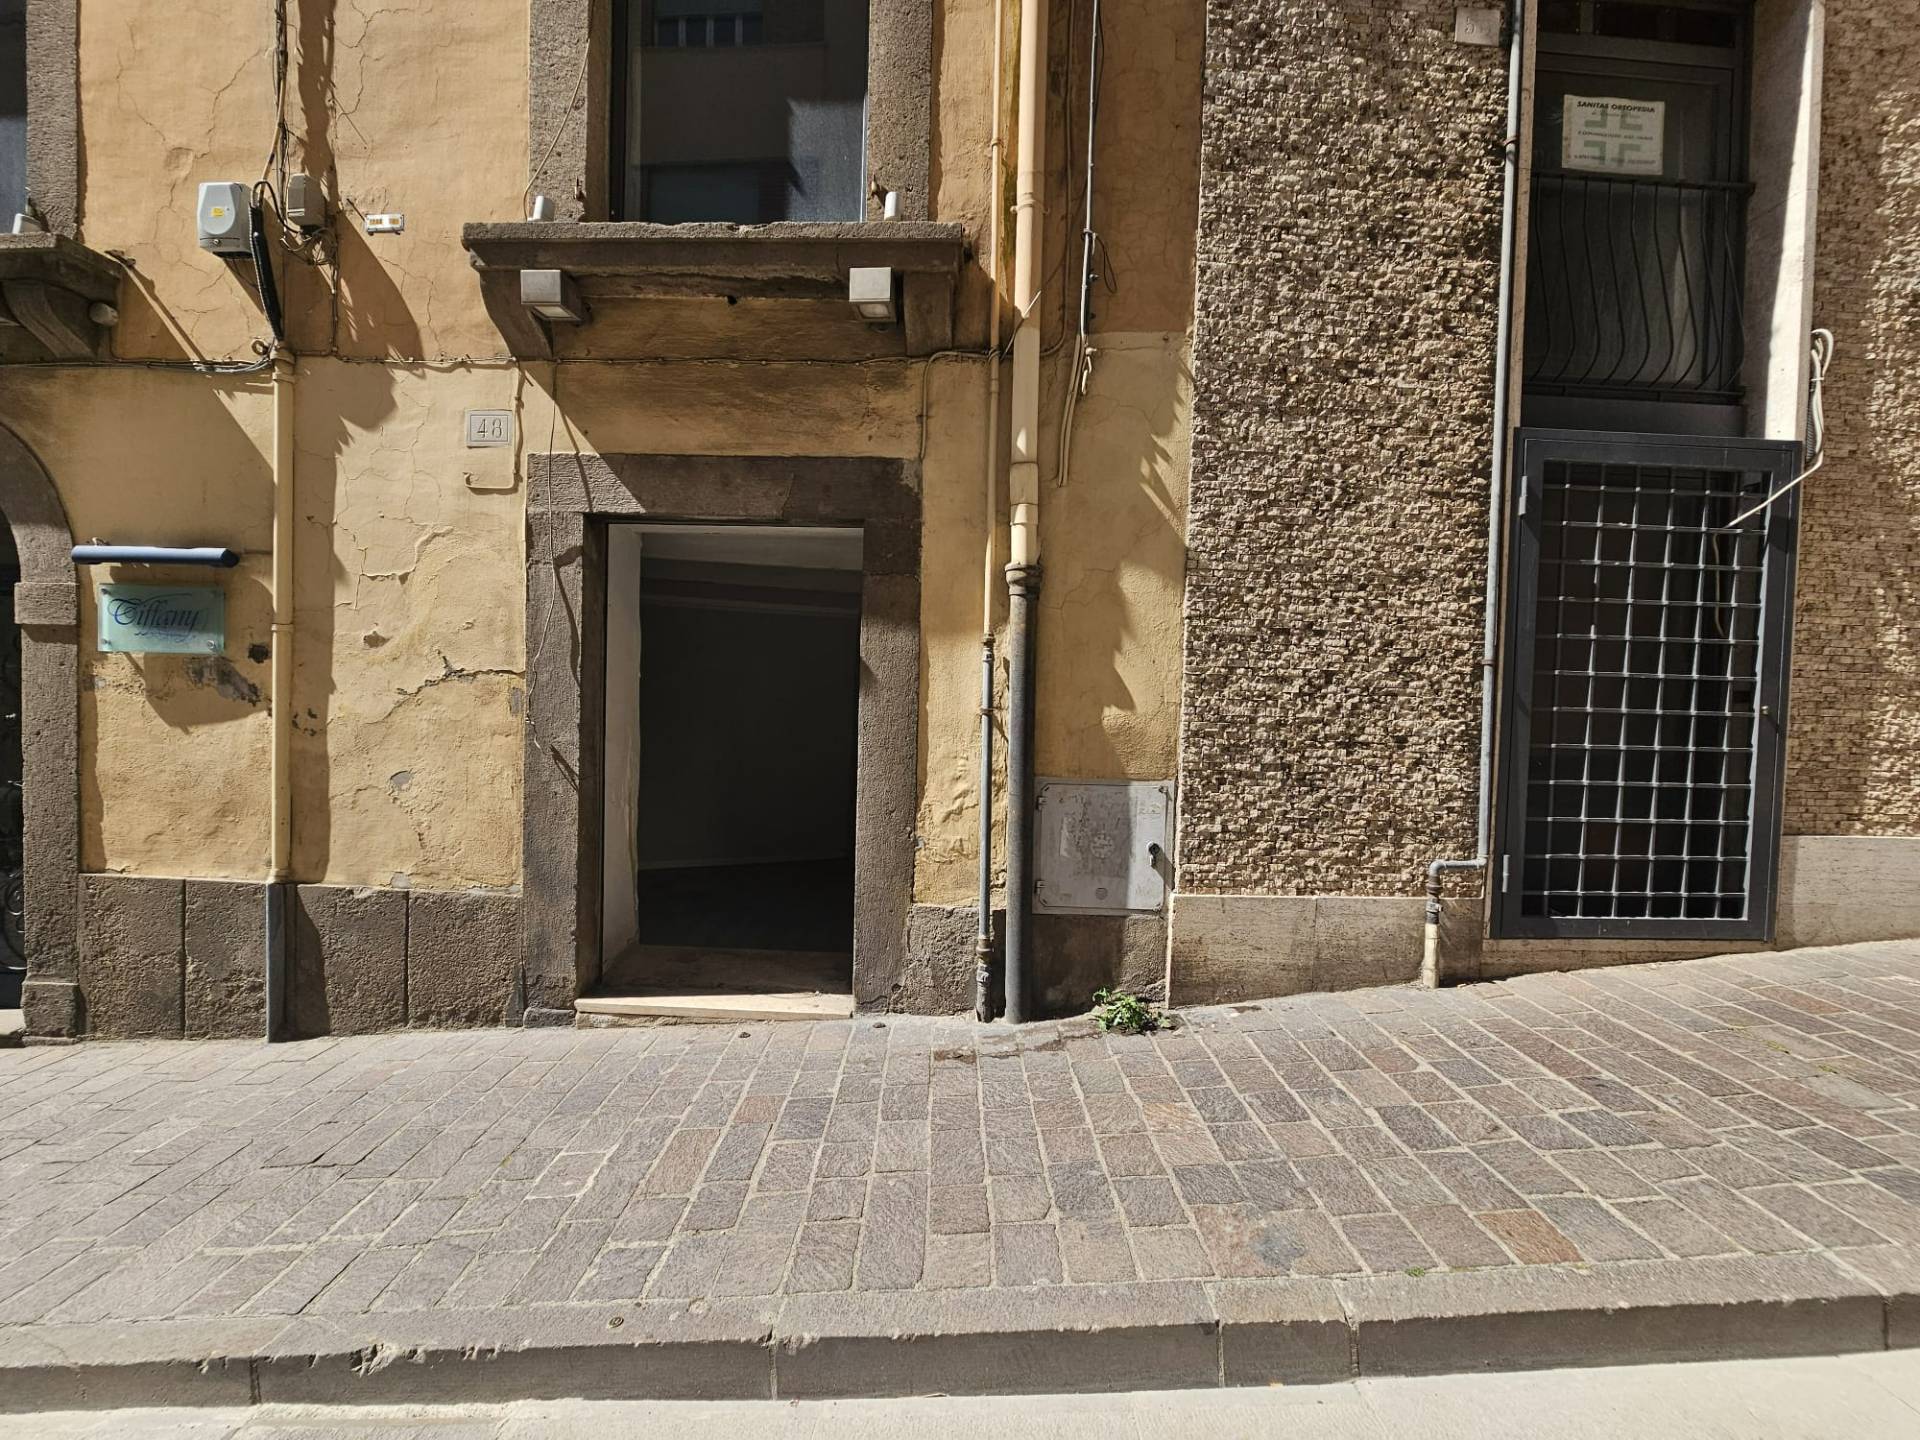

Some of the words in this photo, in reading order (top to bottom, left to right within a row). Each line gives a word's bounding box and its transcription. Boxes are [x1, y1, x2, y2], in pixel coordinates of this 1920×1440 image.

[1577, 101, 1609, 109] SANITAS
[476, 418, 502, 438] 48
[107, 593, 199, 636] Tiffany
